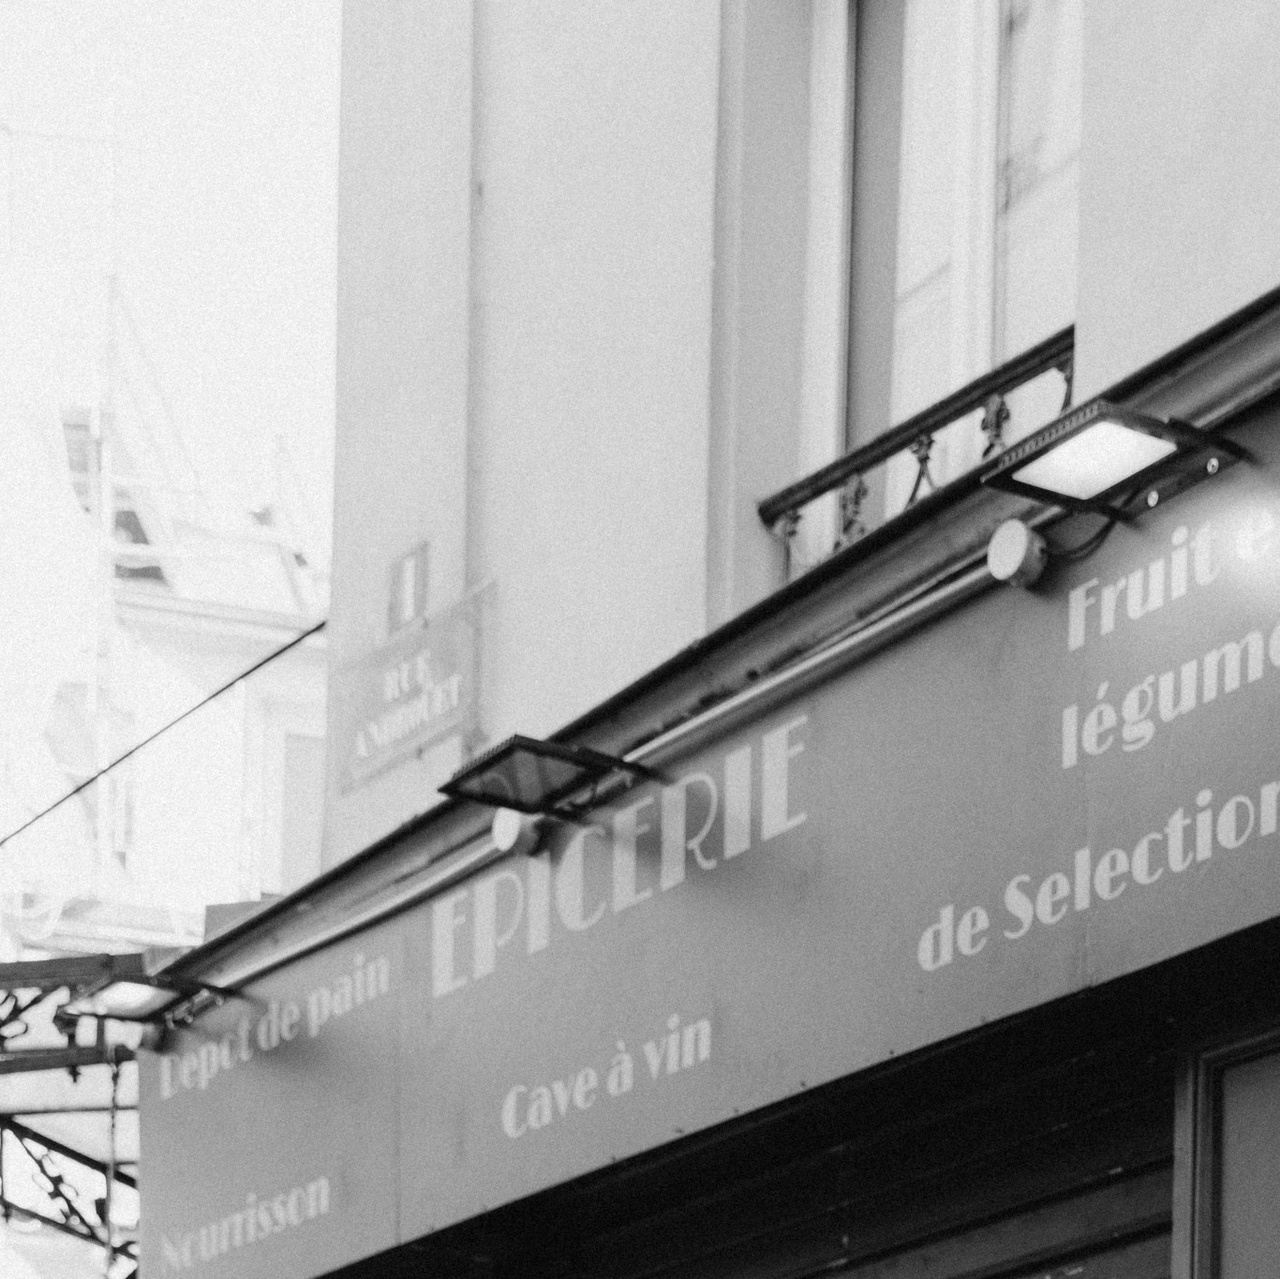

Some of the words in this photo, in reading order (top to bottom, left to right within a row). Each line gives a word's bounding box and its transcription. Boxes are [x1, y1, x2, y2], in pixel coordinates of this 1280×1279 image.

[1068, 520, 1220, 652] Fruit
[432, 715, 808, 998] EPICERIE
[917, 903, 990, 972] de
[257, 1001, 301, 1051] de
[307, 952, 390, 1038] pain
[501, 1067, 598, 1139] Cave
[607, 1040, 634, 1097] à
[643, 1013, 711, 1081] vin
[162, 1176, 330, 1273] Nourrisson
